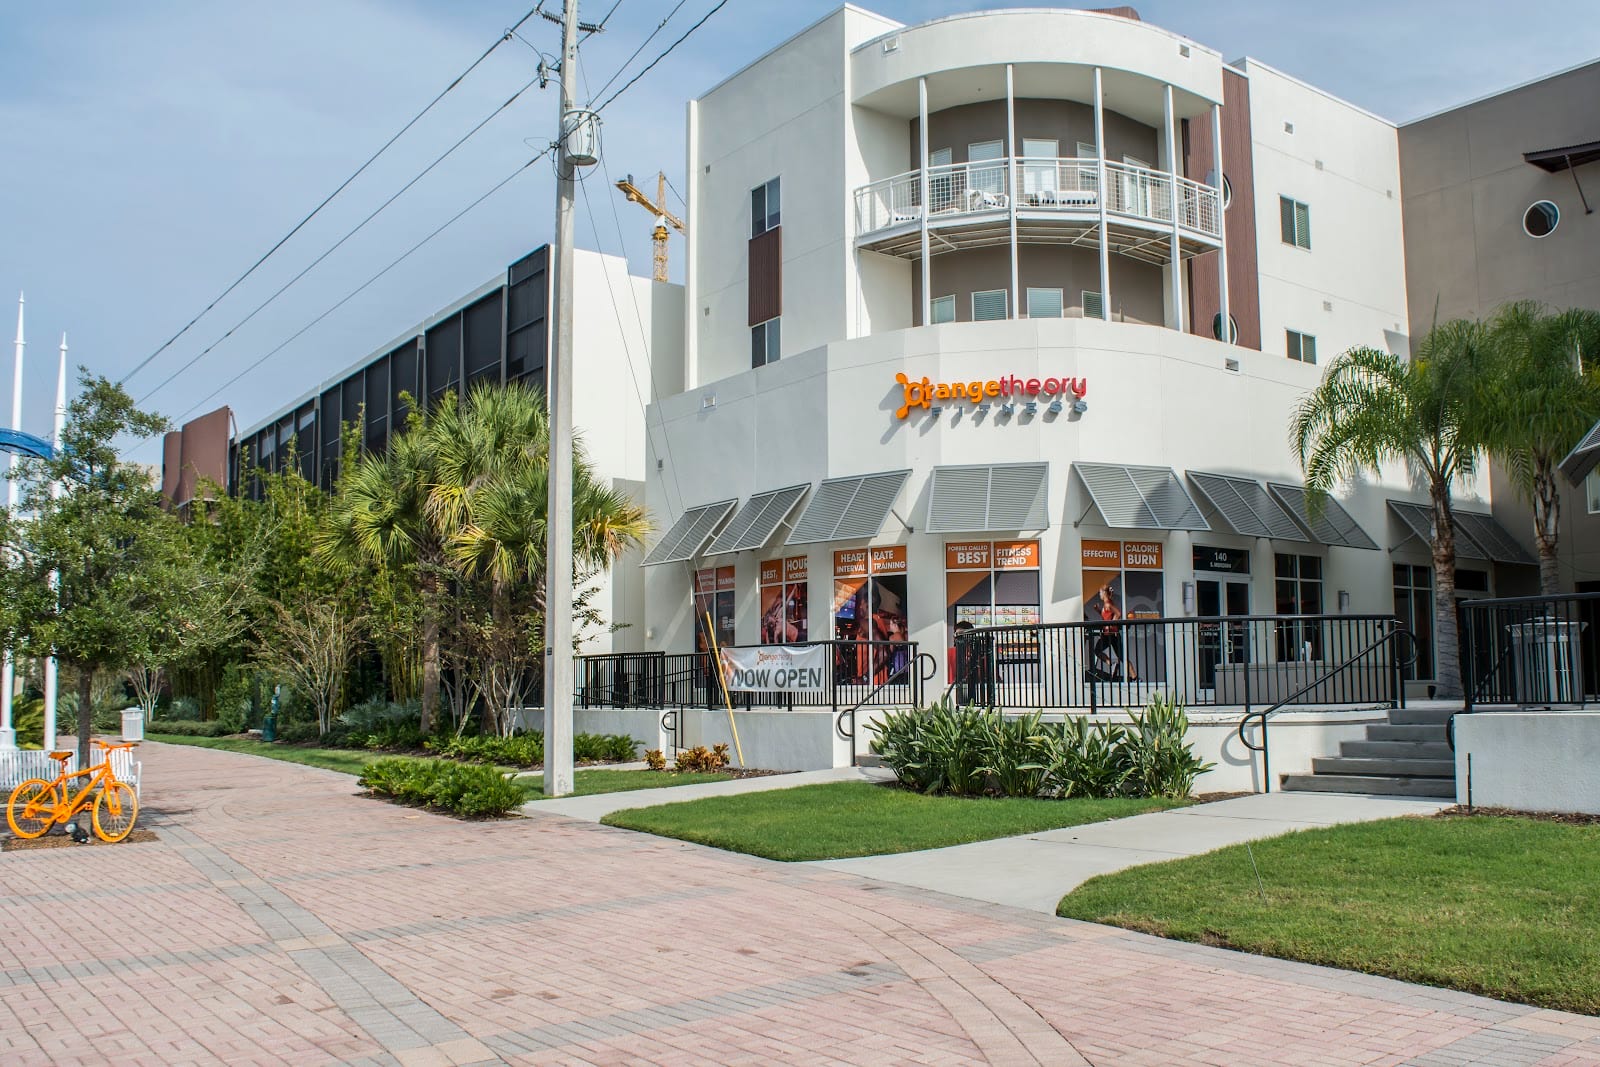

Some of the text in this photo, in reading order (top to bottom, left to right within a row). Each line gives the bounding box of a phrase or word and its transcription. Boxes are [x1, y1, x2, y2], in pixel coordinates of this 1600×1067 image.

[931, 400, 1088, 417] FITNESS
[996, 547, 1032, 557] FITNESS
[1083, 549, 1118, 558] EFFECTIVE
[1125, 544, 1159, 553] CALORIE
[841, 550, 894, 563] HEART RATE
[957, 551, 989, 564] BEST
[996, 557, 1027, 566] TREND
[1127, 554, 1157, 565] BURN
[1214, 551, 1228, 561] 140
[837, 561, 906, 573] INTERVAL TRAINING
[731, 668, 822, 688] NOW OPEN
